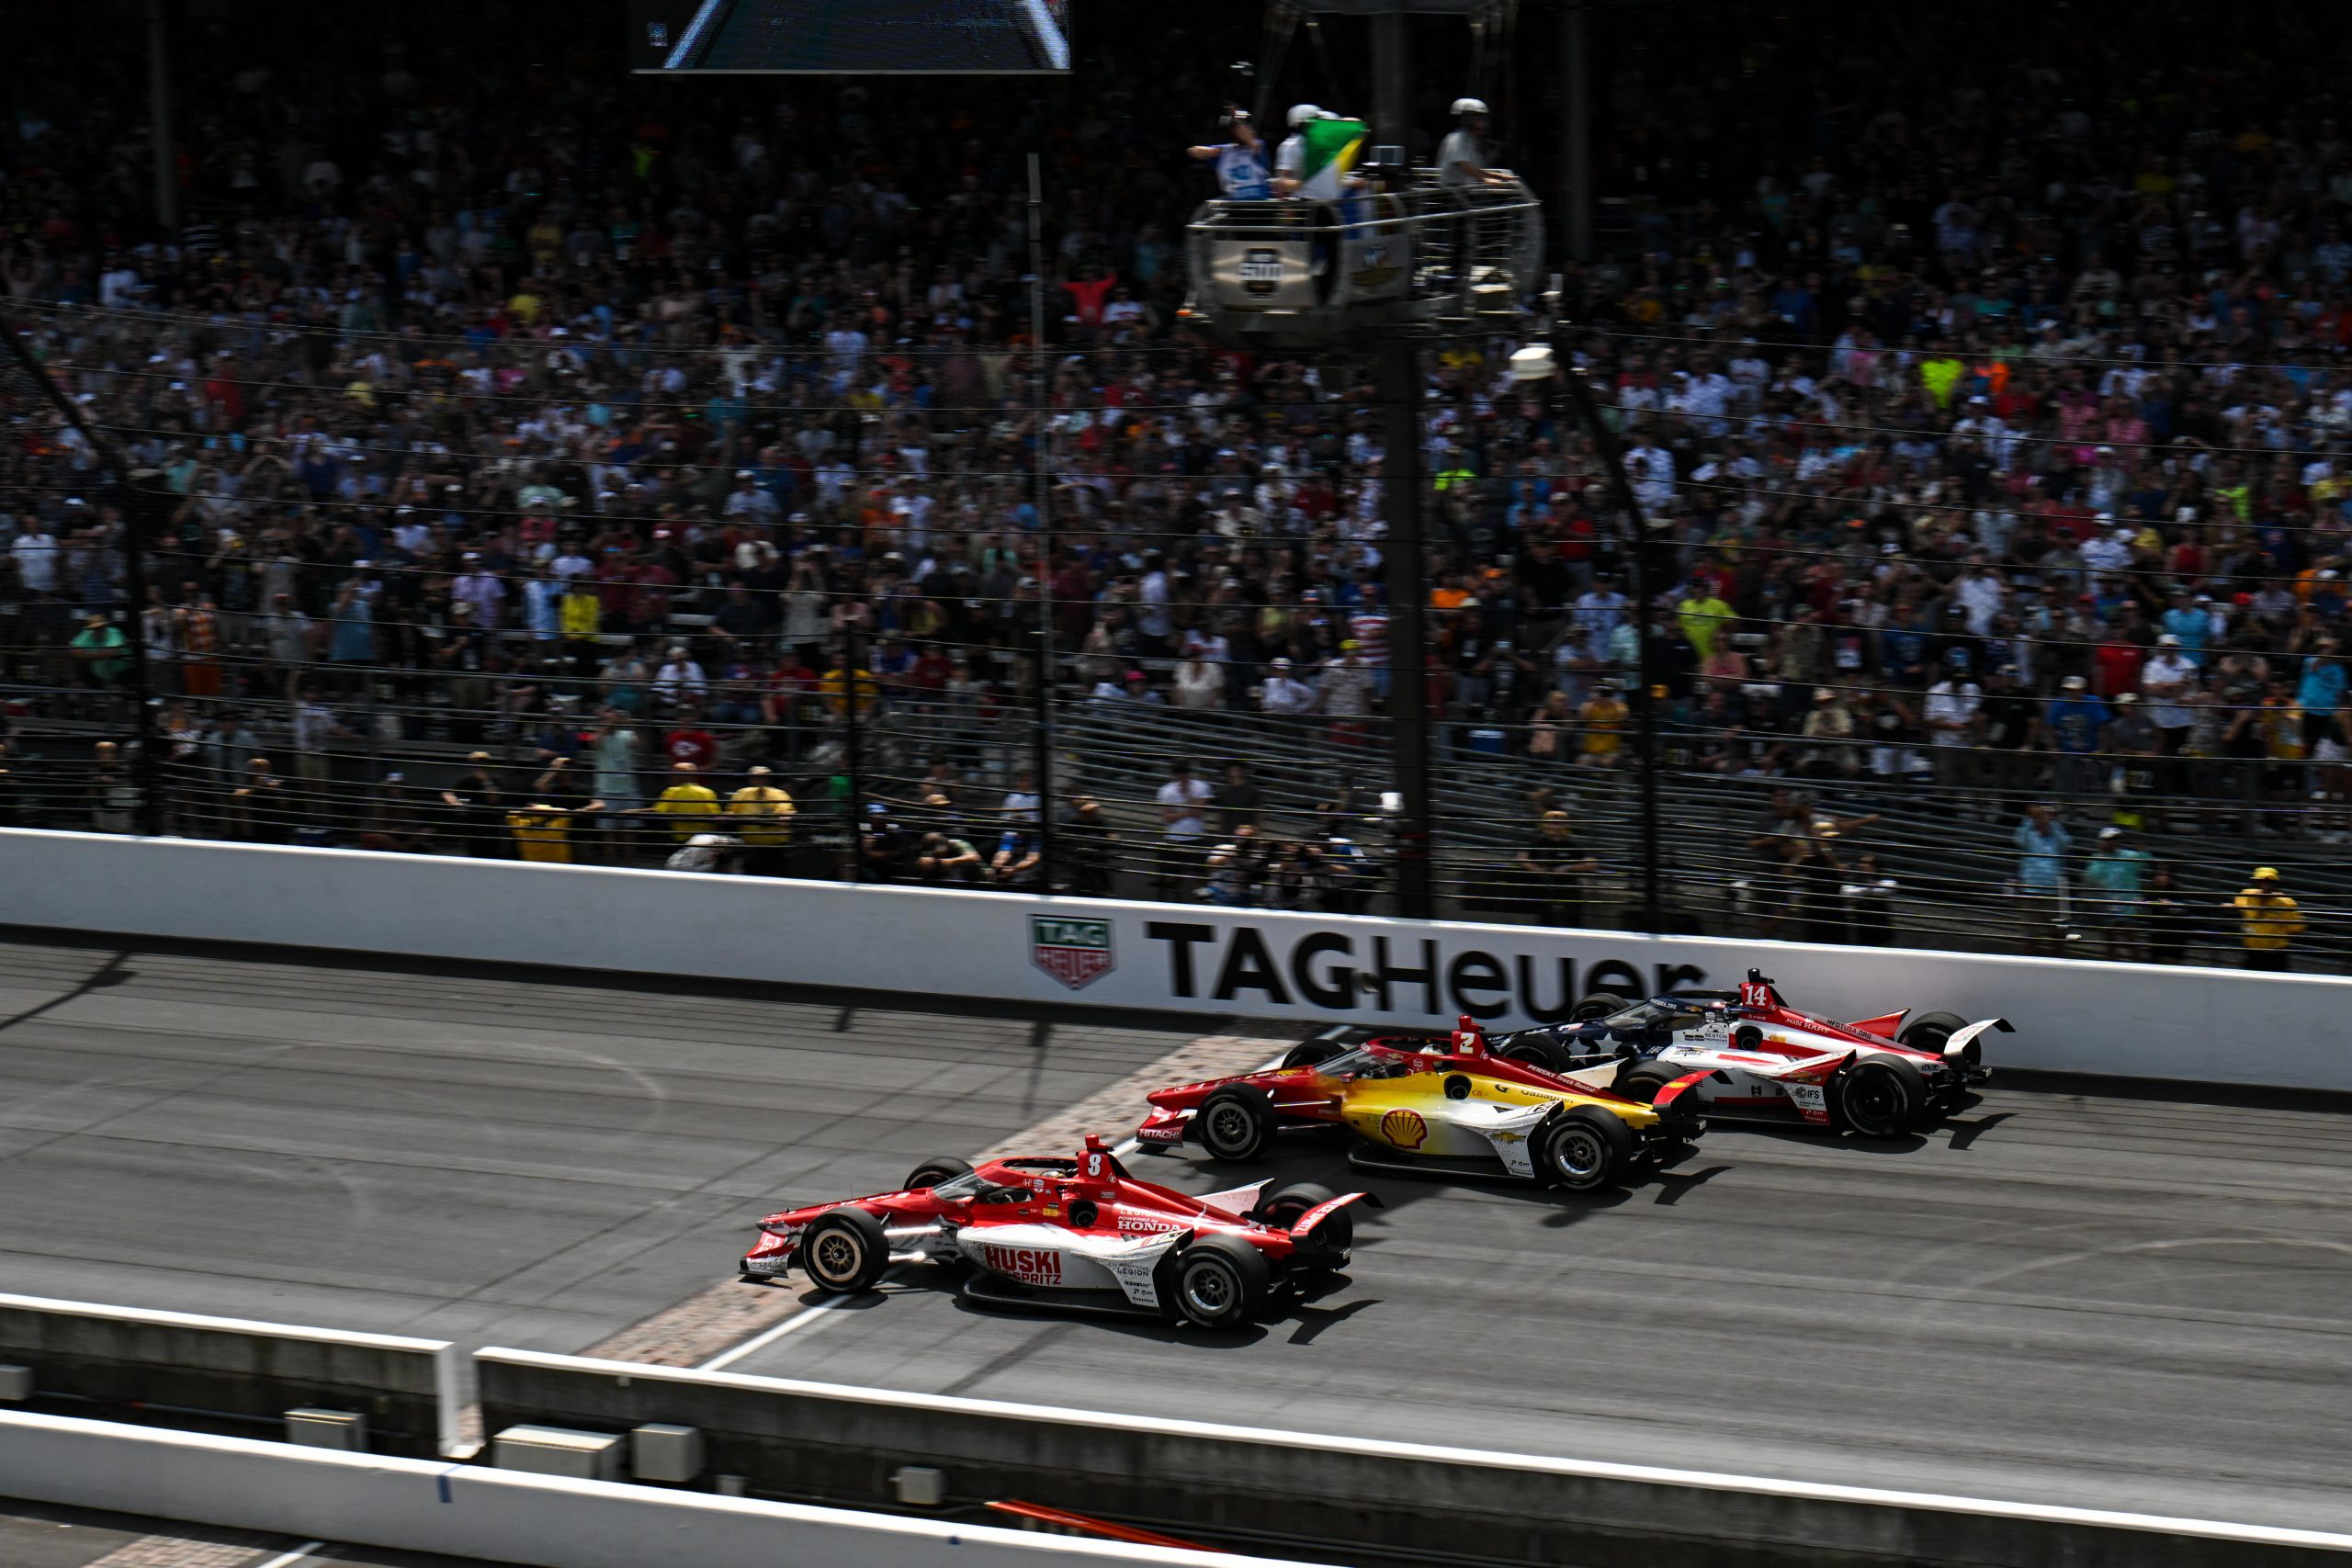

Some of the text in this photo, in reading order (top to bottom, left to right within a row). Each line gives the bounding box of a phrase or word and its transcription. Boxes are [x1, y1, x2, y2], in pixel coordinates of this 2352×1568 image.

[1035, 922, 1107, 945] TAG
[1746, 985, 1767, 1006] 14
[1827, 1019, 1871, 1039] HFOTUSA.ORG
[1459, 1032, 1475, 1054] 2
[1527, 1064, 1595, 1093] PENSKE Truck Rental
[1807, 1090, 1819, 1099] IFS
[1140, 1129, 1180, 1139] HITACHI
[1088, 1154, 1102, 1176] 8
[1117, 1221, 1181, 1231] HONDA
[985, 1246, 1061, 1273] HUSKI
[1013, 1272, 1061, 1286] SPRITZ
[1118, 1268, 1148, 1276] LEGION
